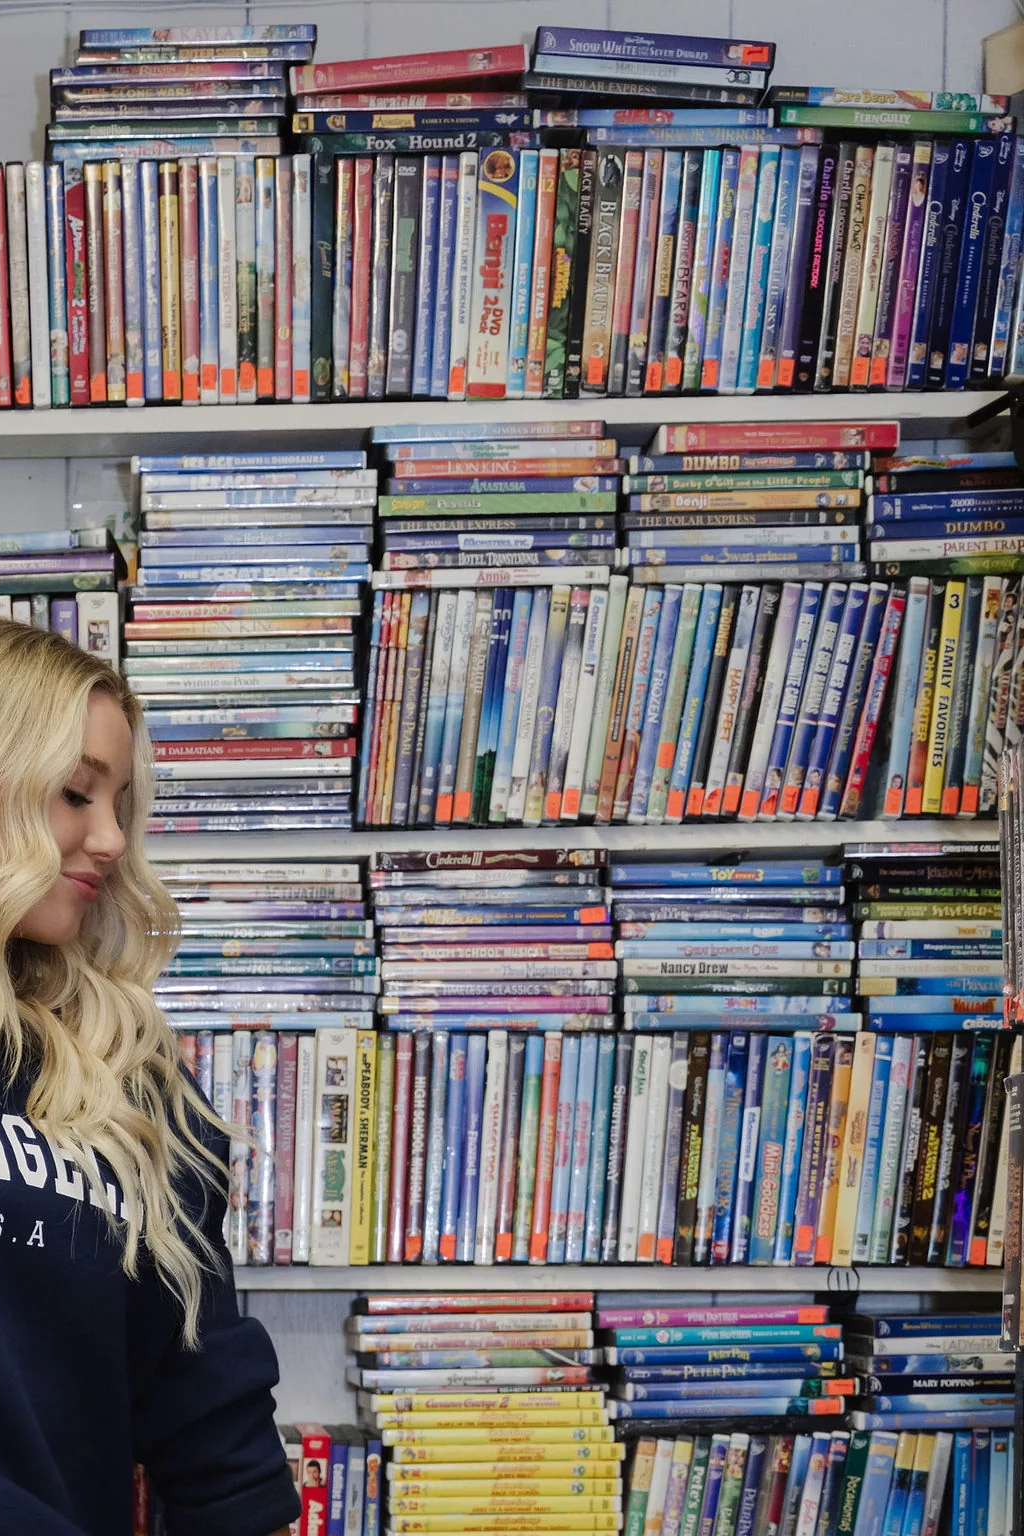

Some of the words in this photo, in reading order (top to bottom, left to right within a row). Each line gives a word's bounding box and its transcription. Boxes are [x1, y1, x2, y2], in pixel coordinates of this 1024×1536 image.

[365, 136, 396, 150] Fox
[410, 134, 463, 149] Hound
[465, 134, 476, 147] 2
[580, 160, 593, 193] BLACK
[579, 196, 591, 233] BEAUTY
[595, 200, 617, 259] BLACK
[479, 213, 508, 289] Benji
[484, 296, 498, 305] 2
[591, 263, 613, 329] BEAUTY
[479, 306, 492, 334] Pack
[489, 309, 504, 335] DVD
[683, 456, 740, 470] DUMBO
[638, 516, 661, 527] THE
[665, 515, 702, 526] POLAR
[705, 514, 756, 525] EXPRESS
[945, 520, 1005, 534] DUMBO
[943, 541, 988, 556] PARENT
[994, 539, 1024, 552] TRAP
[924, 648, 936, 683] JOHN
[938, 638, 955, 687] FAMILY
[647, 669, 665, 724] FROZEN
[917, 687, 933, 742] CARTER
[932, 695, 950, 768] FAVORITES
[660, 961, 697, 976] Nancy
[699, 961, 728, 974] Drew
[280, 1061, 297, 1092] Mary
[414, 1076, 425, 1108] HIGH
[278, 1103, 294, 1151] Poppins
[412, 1110, 424, 1154] SCHOOL
[758, 1142, 783, 1237] Mini-Goddess
[684, 1365, 718, 1378] PETER
[720, 1364, 746, 1377] PAN
[687, 1465, 706, 1510] Pete's
[839, 1475, 861, 1532] POCAHONTAS
